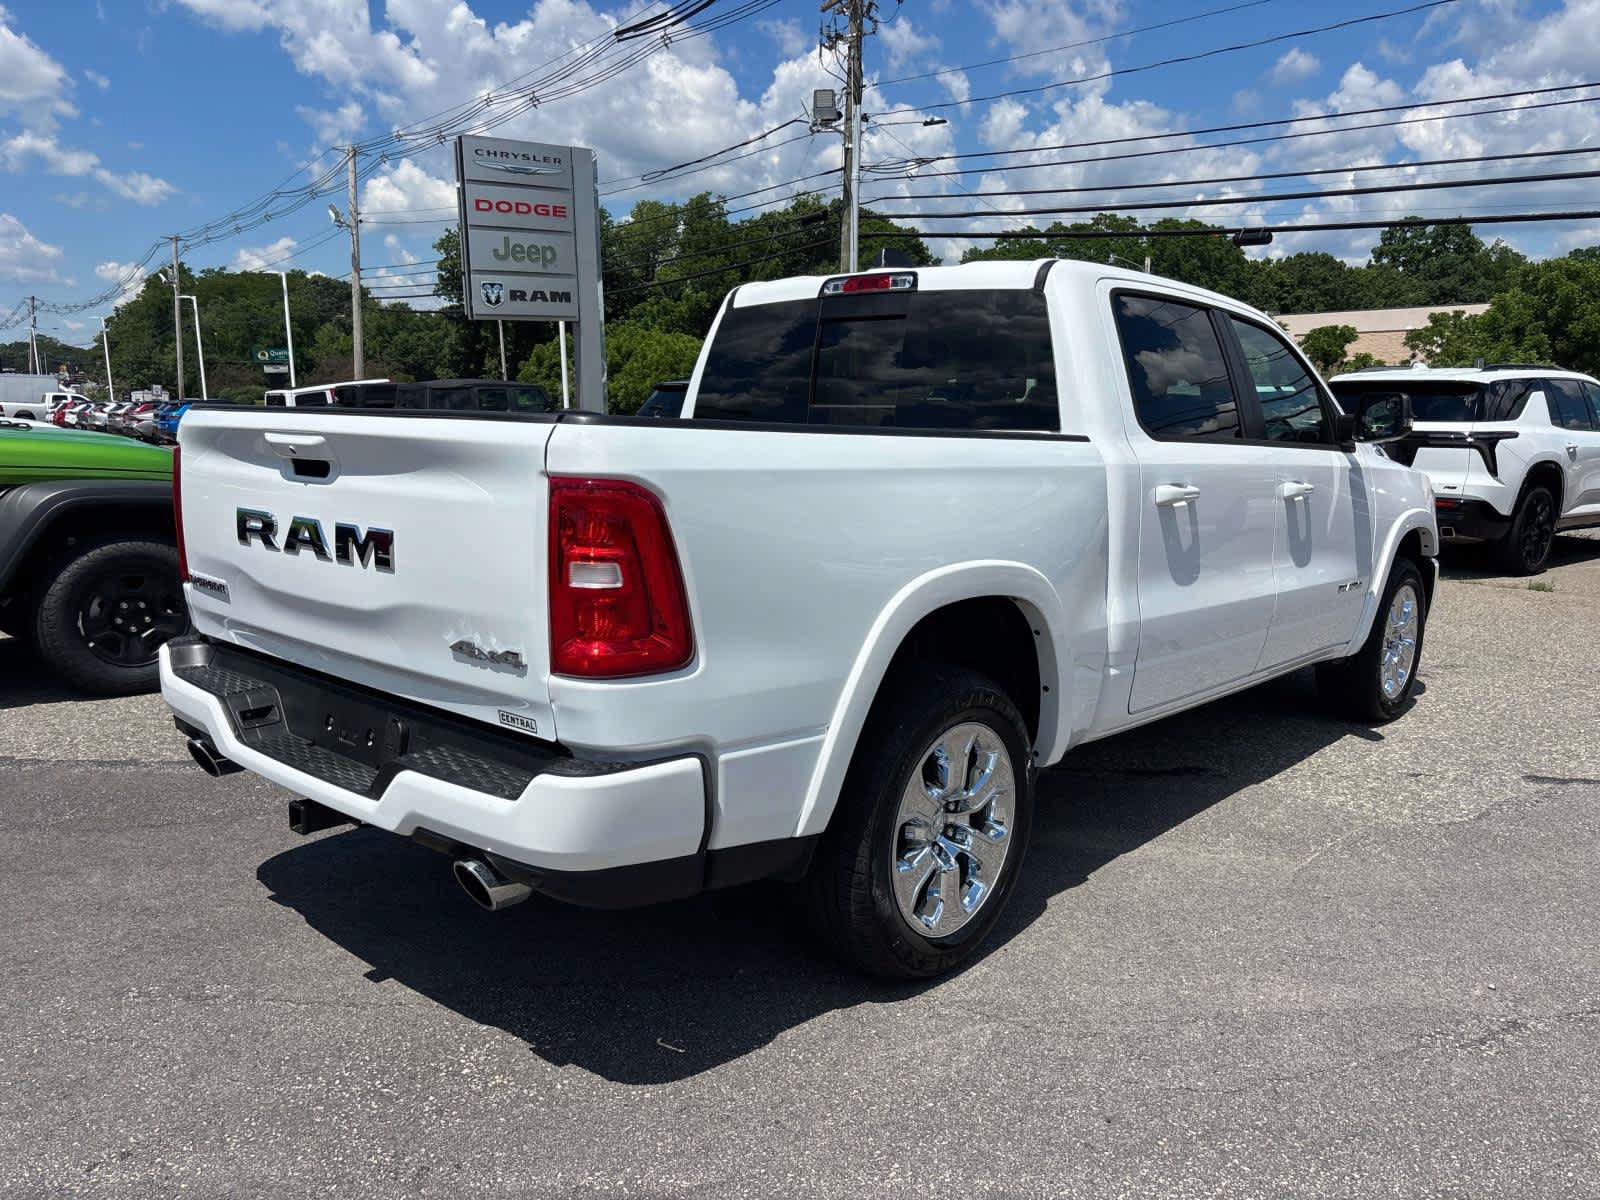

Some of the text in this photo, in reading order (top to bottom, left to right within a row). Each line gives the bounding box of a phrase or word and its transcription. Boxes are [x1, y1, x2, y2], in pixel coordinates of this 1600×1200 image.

[474, 148, 562, 165] CHRYSLER
[474, 198, 568, 218] DODGE
[492, 236, 558, 269] Jeep
[509, 289, 572, 303] RAM
[236, 507, 395, 574] RAM
[500, 712, 536, 730] CENTRAL
